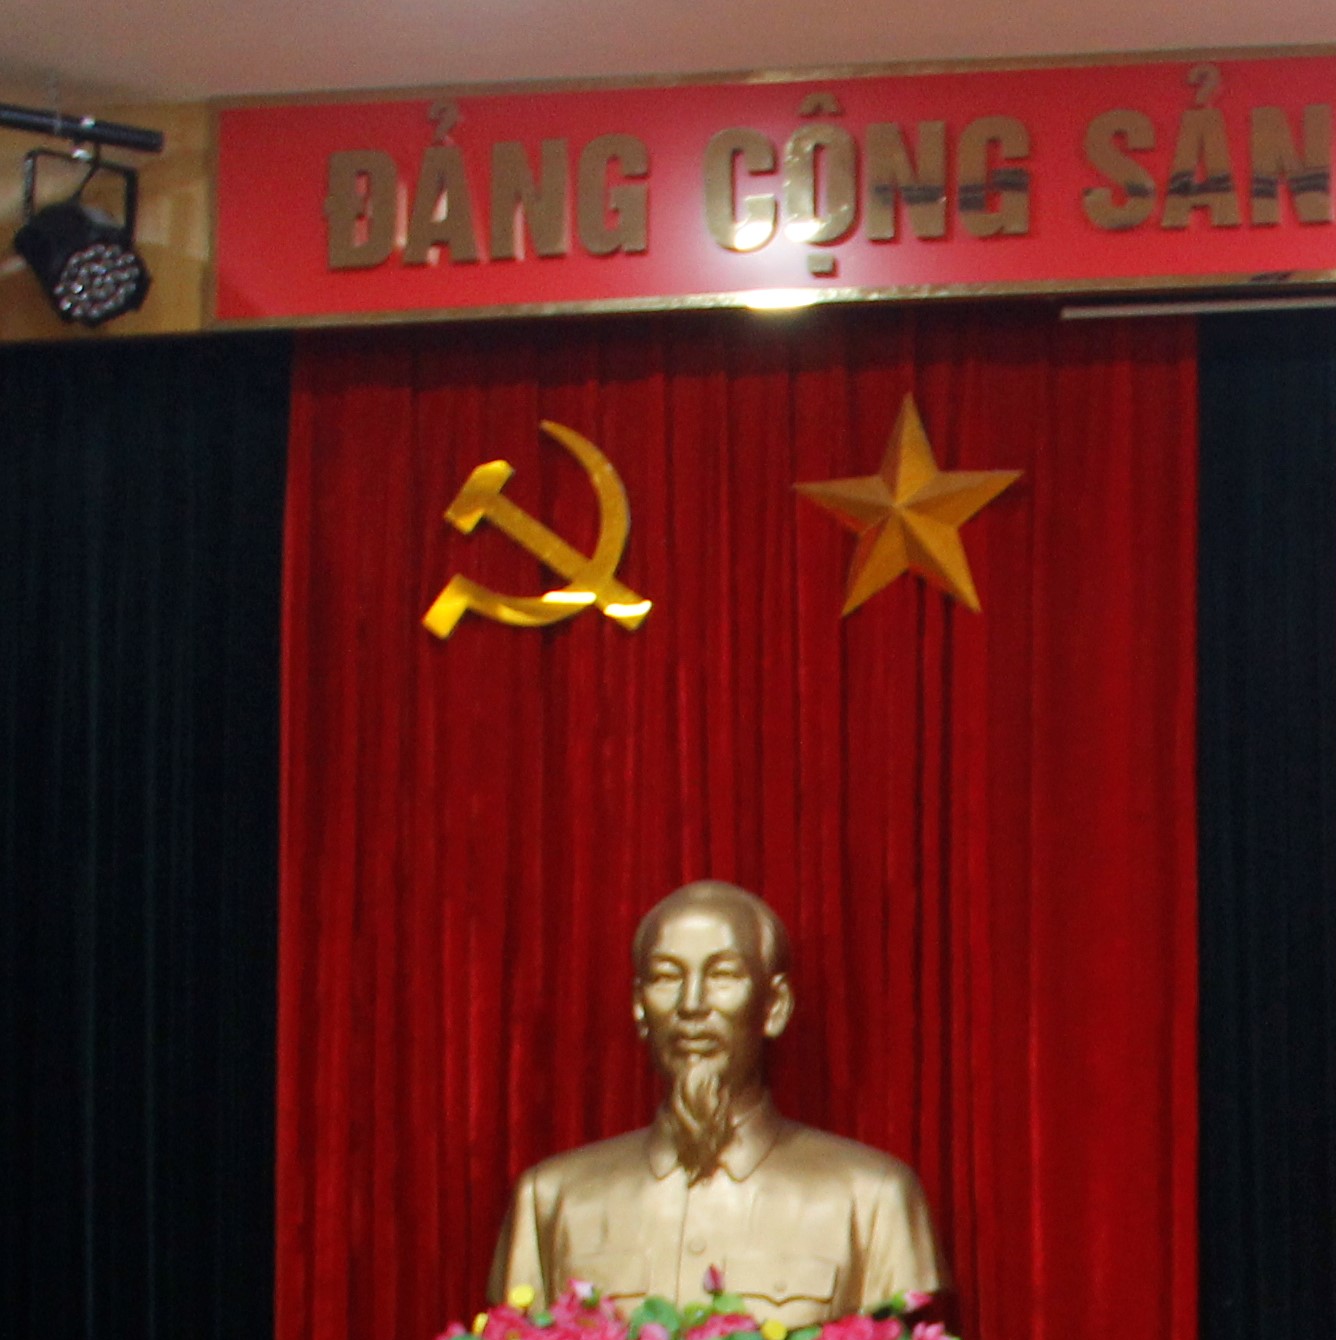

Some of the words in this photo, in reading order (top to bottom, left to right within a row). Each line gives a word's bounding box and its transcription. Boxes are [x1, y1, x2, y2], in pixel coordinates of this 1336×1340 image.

[324, 101, 652, 270] ĐẢNG
[702, 93, 1032, 276] CỘNG
[1082, 65, 1336, 232] SẢN
